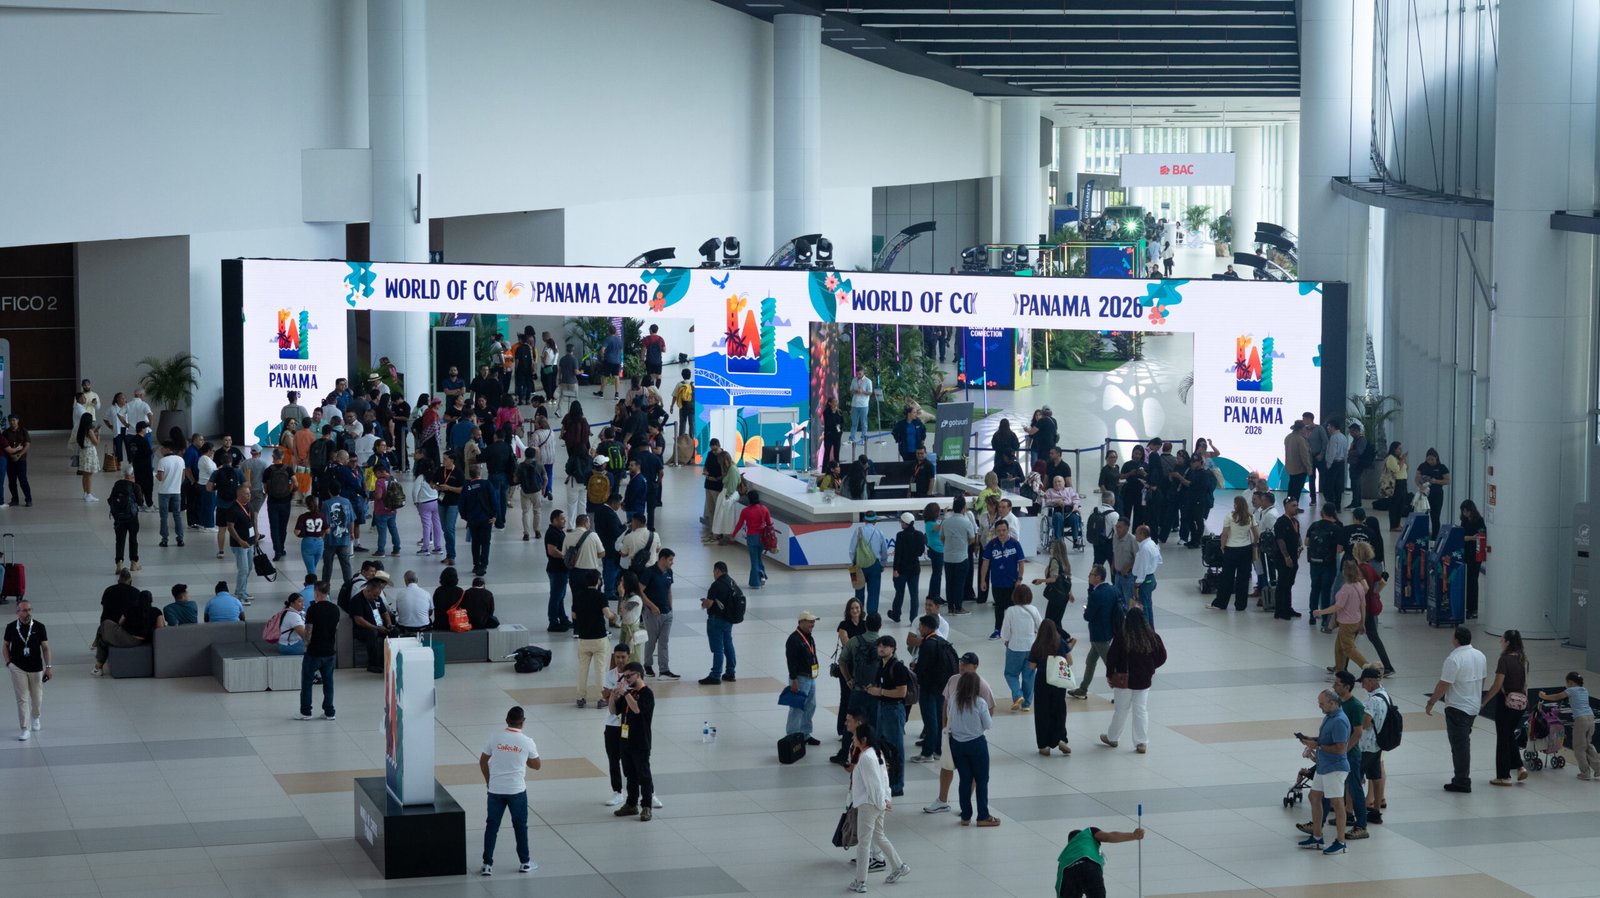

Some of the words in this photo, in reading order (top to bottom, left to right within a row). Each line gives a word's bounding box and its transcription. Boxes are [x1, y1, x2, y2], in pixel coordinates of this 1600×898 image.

[1172, 164, 1194, 175] BAC
[385, 278, 440, 300] WORLD
[447, 280, 467, 301] OF
[536, 281, 601, 305] PANAMA
[607, 283, 648, 305] 2026
[48, 297, 57, 310] 2
[852, 290, 913, 312] WORLD
[920, 292, 942, 313] OF
[1019, 294, 1091, 318] PANAMA
[1098, 296, 1144, 318] 2026
[269, 372, 318, 389] PANAMA
[1225, 396, 1247, 404] WORLD
[1250, 396, 1257, 404] OF
[1260, 397, 1283, 405] COFFEE
[1224, 406, 1283, 424] PANAMA
[1245, 426, 1262, 434] 2026
